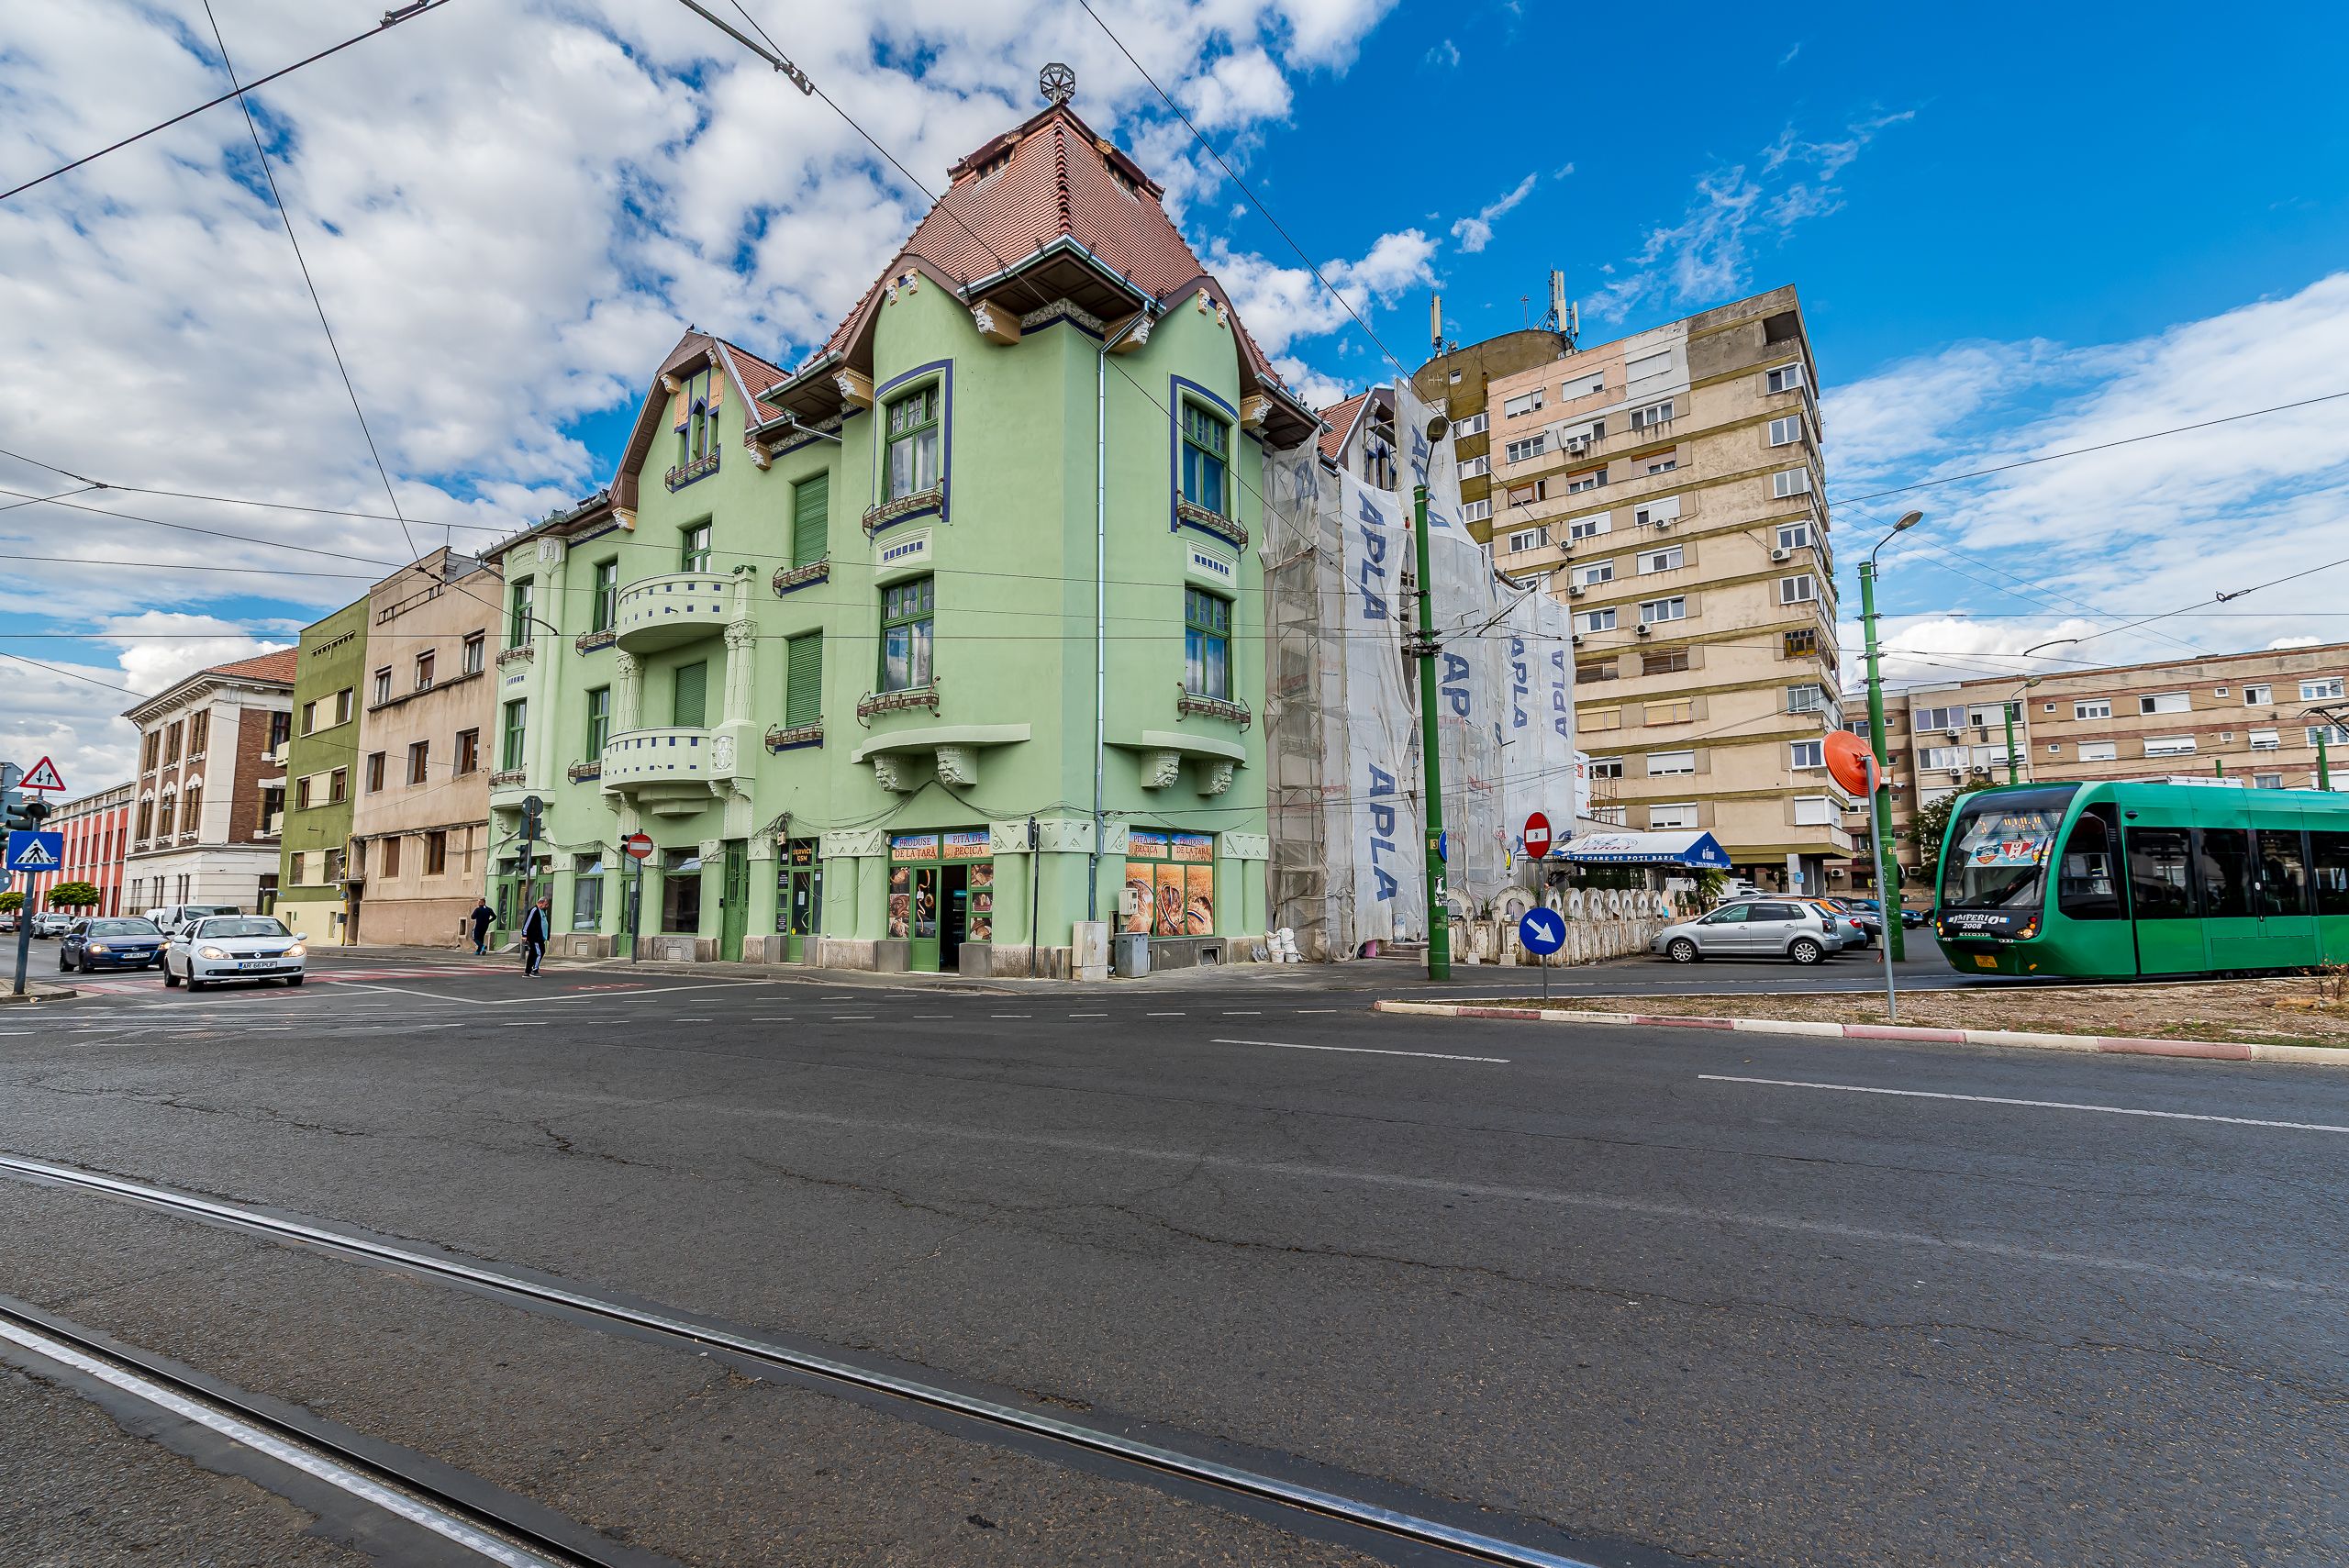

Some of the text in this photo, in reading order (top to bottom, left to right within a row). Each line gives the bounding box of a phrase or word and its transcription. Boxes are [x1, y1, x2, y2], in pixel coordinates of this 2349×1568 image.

[1358, 490, 1387, 619] APLA
[1510, 638, 1528, 728] APLA
[1551, 650, 1568, 740] APLA
[895, 850, 905, 858] DE
[906, 849, 916, 857] LA
[899, 837, 931, 847] PRODUSE
[1368, 762, 1398, 902] APLA
